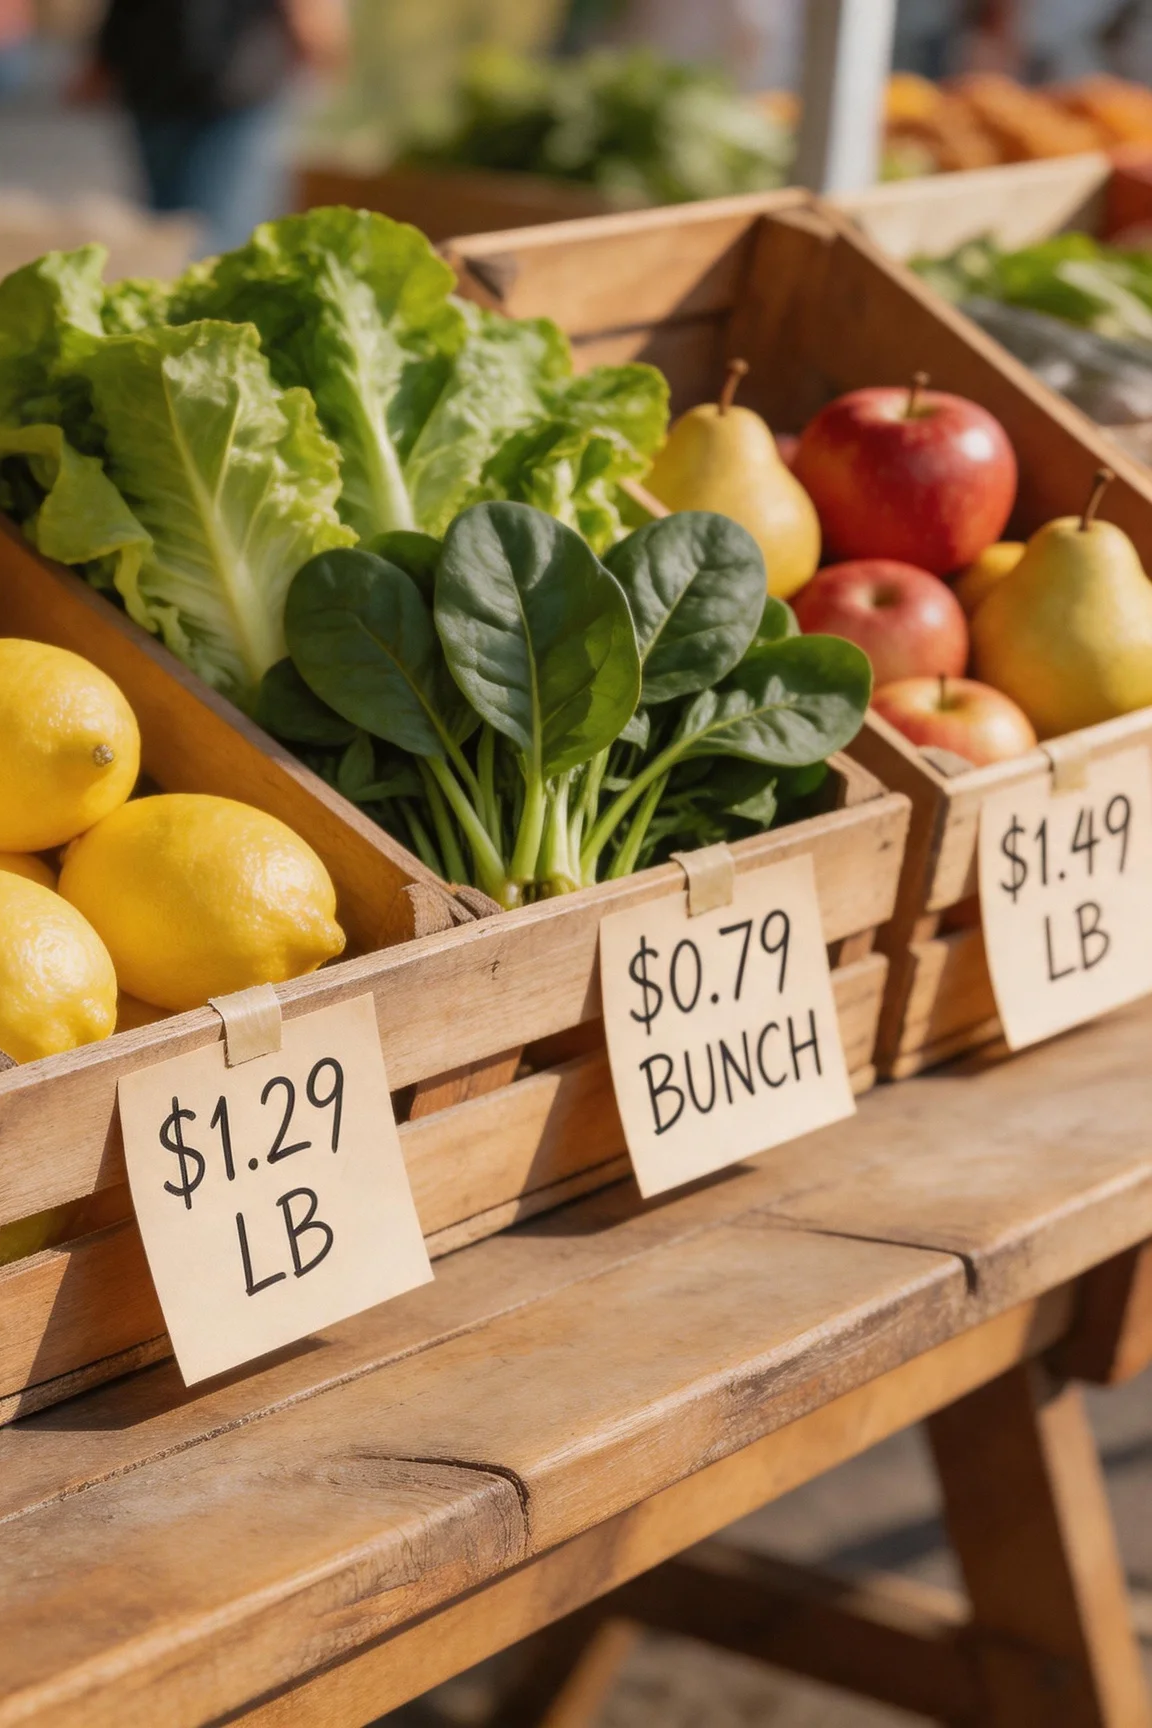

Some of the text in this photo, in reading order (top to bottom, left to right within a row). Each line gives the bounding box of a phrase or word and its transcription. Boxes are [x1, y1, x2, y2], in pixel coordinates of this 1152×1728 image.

[1000, 793, 1131, 904] $1.49
[629, 909, 790, 1036] $0.79
[1044, 901, 1111, 982] LB
[639, 1009, 822, 1136] BUNCH
[159, 1056, 345, 1210] $1.29
[235, 1187, 334, 1297] LB
